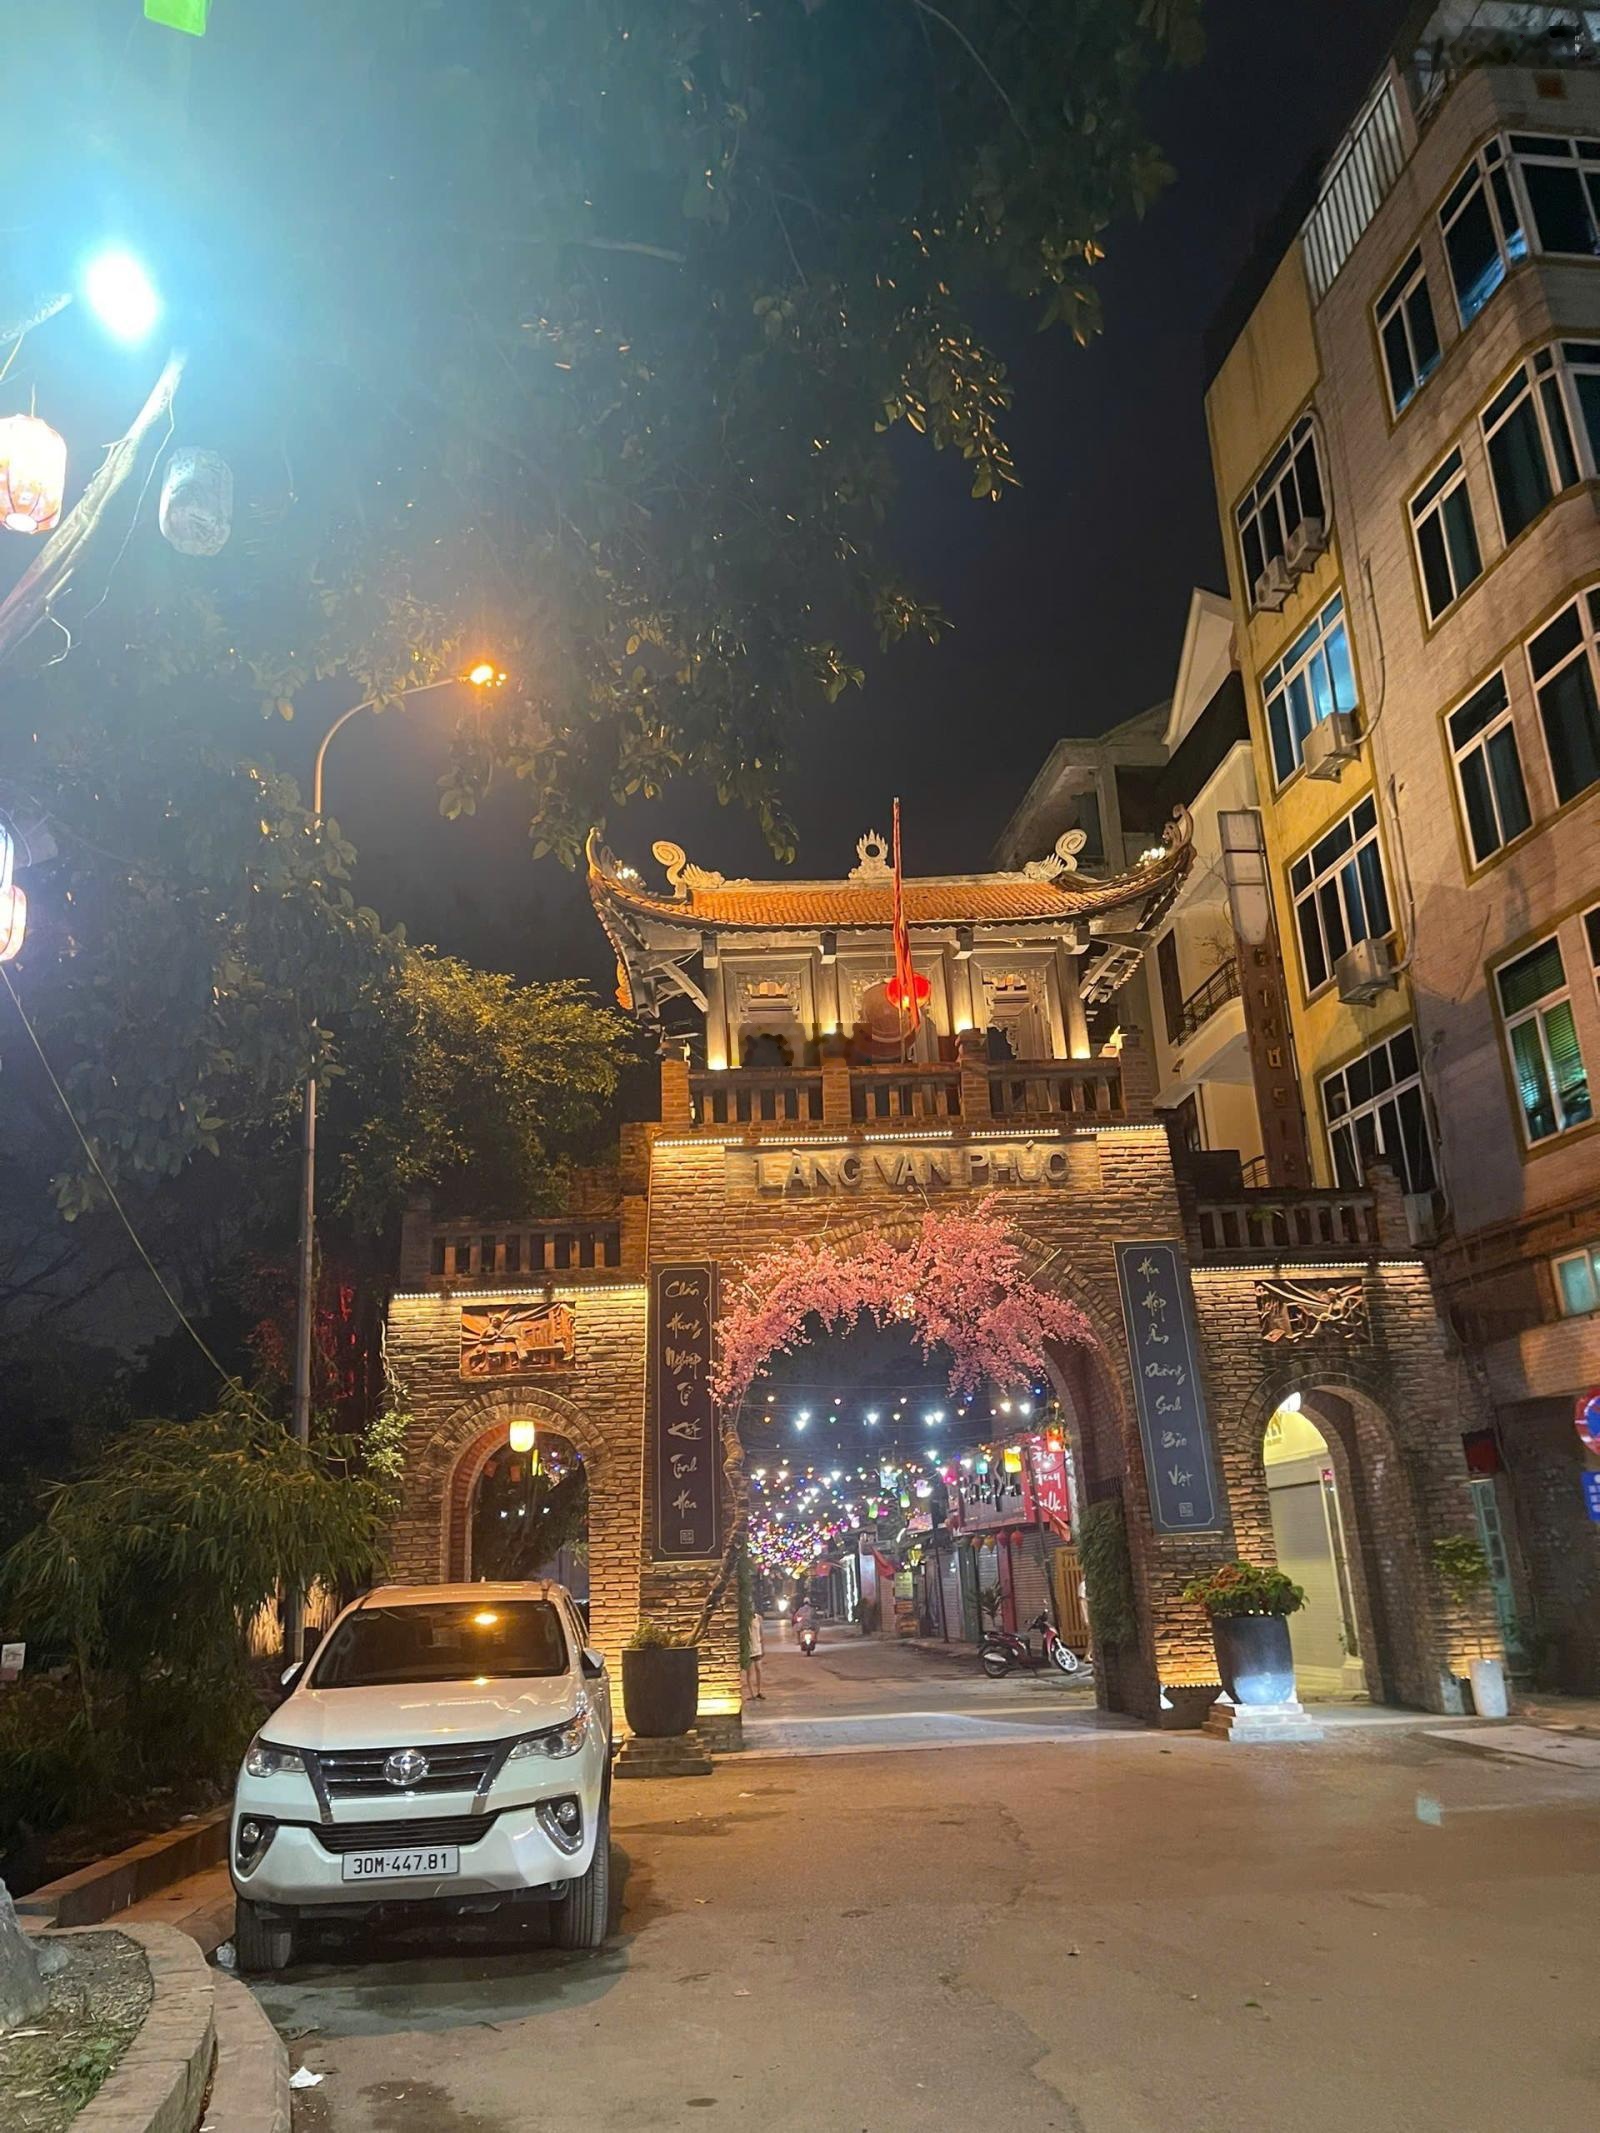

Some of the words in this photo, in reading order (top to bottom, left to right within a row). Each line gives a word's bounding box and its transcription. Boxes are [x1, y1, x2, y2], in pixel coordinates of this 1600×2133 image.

[755, 1148, 862, 1192] LÀNG
[965, 1140, 1070, 1187] PHÚC
[353, 1853, 447, 1874] 30M-447.81
